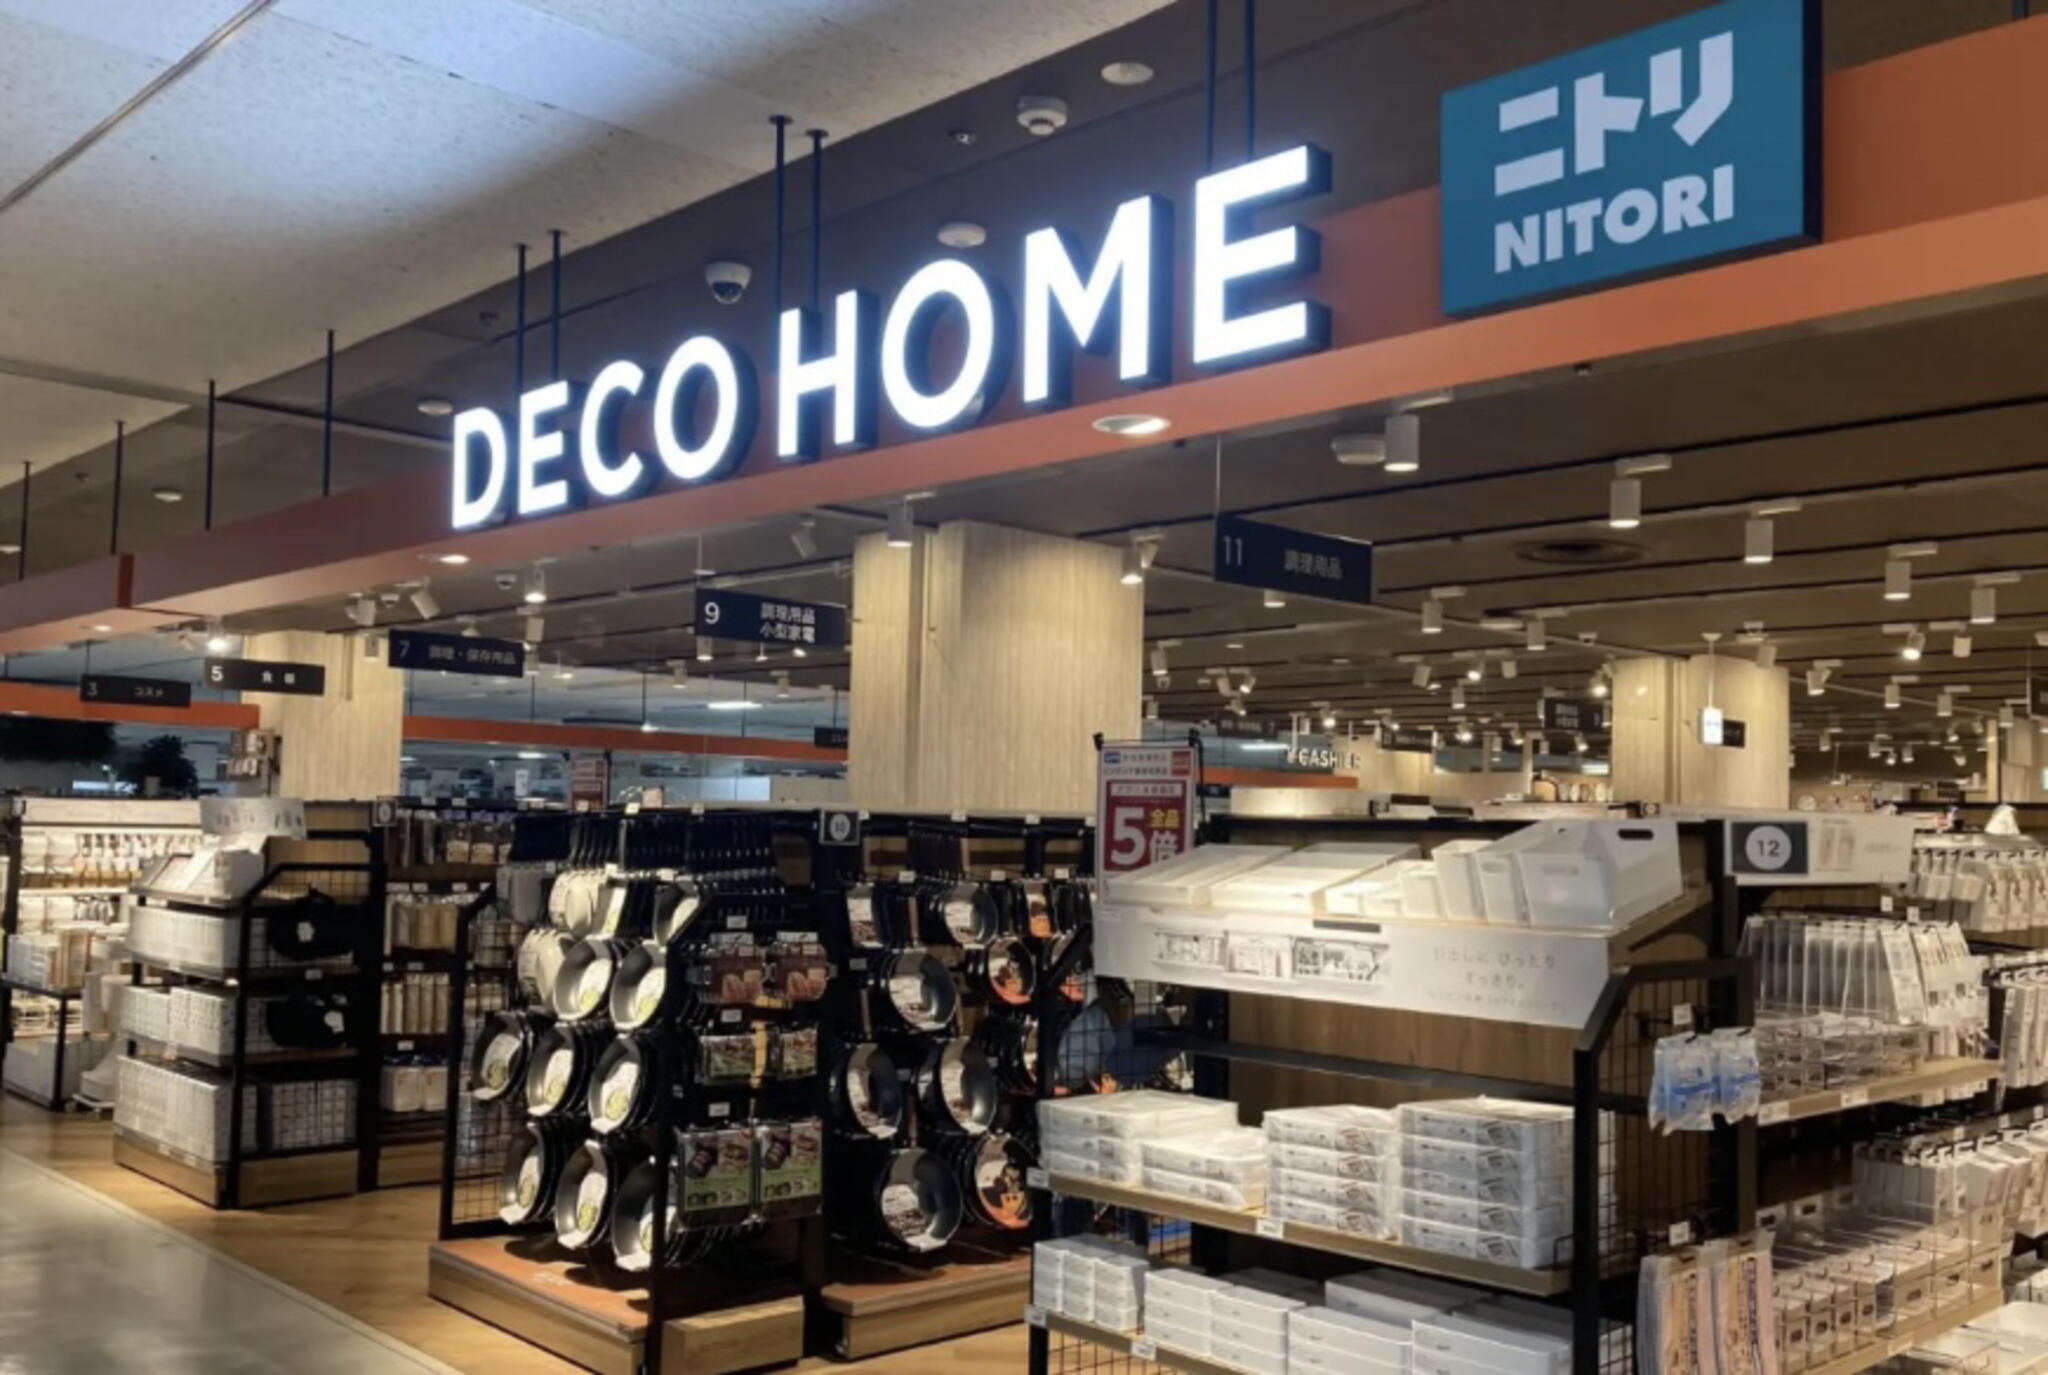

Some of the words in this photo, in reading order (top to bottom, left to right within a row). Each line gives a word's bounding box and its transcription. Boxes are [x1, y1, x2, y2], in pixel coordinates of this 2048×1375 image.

[1495, 30, 1734, 197] ニトリ
[1494, 163, 1734, 275] NITORI
[451, 335, 739, 530] DECO
[777, 144, 1309, 458] HOME
[1223, 535, 1243, 567] 11
[1284, 549, 1343, 580] 調理用品
[704, 601, 721, 625] 9
[760, 601, 816, 625] 調理用品
[760, 621, 816, 644] 小型家電
[397, 640, 411, 659] 7
[210, 665, 223, 682] 5
[1110, 806, 1147, 868] 5
[1756, 839, 1781, 858] 12
